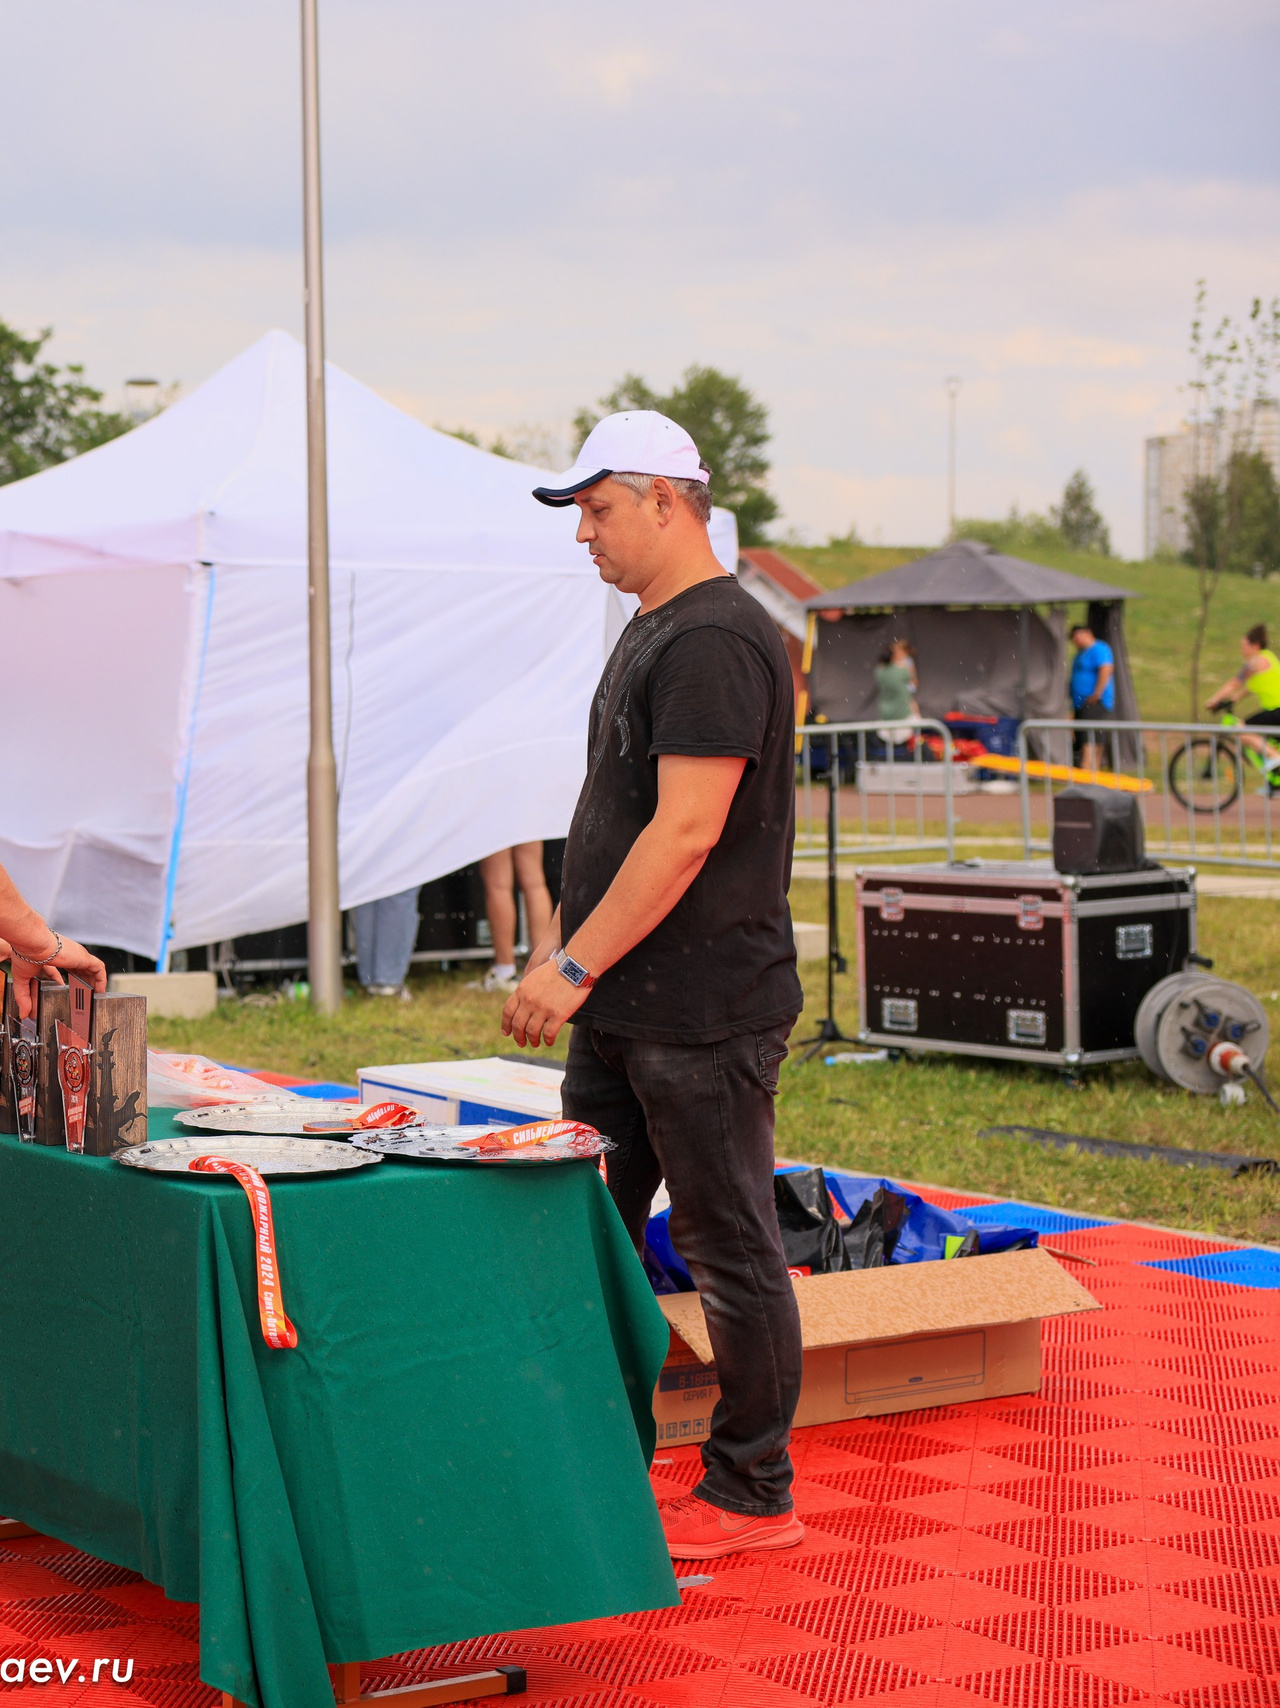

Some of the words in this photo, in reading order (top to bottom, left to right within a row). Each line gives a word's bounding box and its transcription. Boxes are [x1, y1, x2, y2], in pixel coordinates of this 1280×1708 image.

[75, 988, 85, 1010] III
[256, 1189, 272, 1254] ПОЖАРНЫЙ
[260, 1258, 275, 1287] 2024
